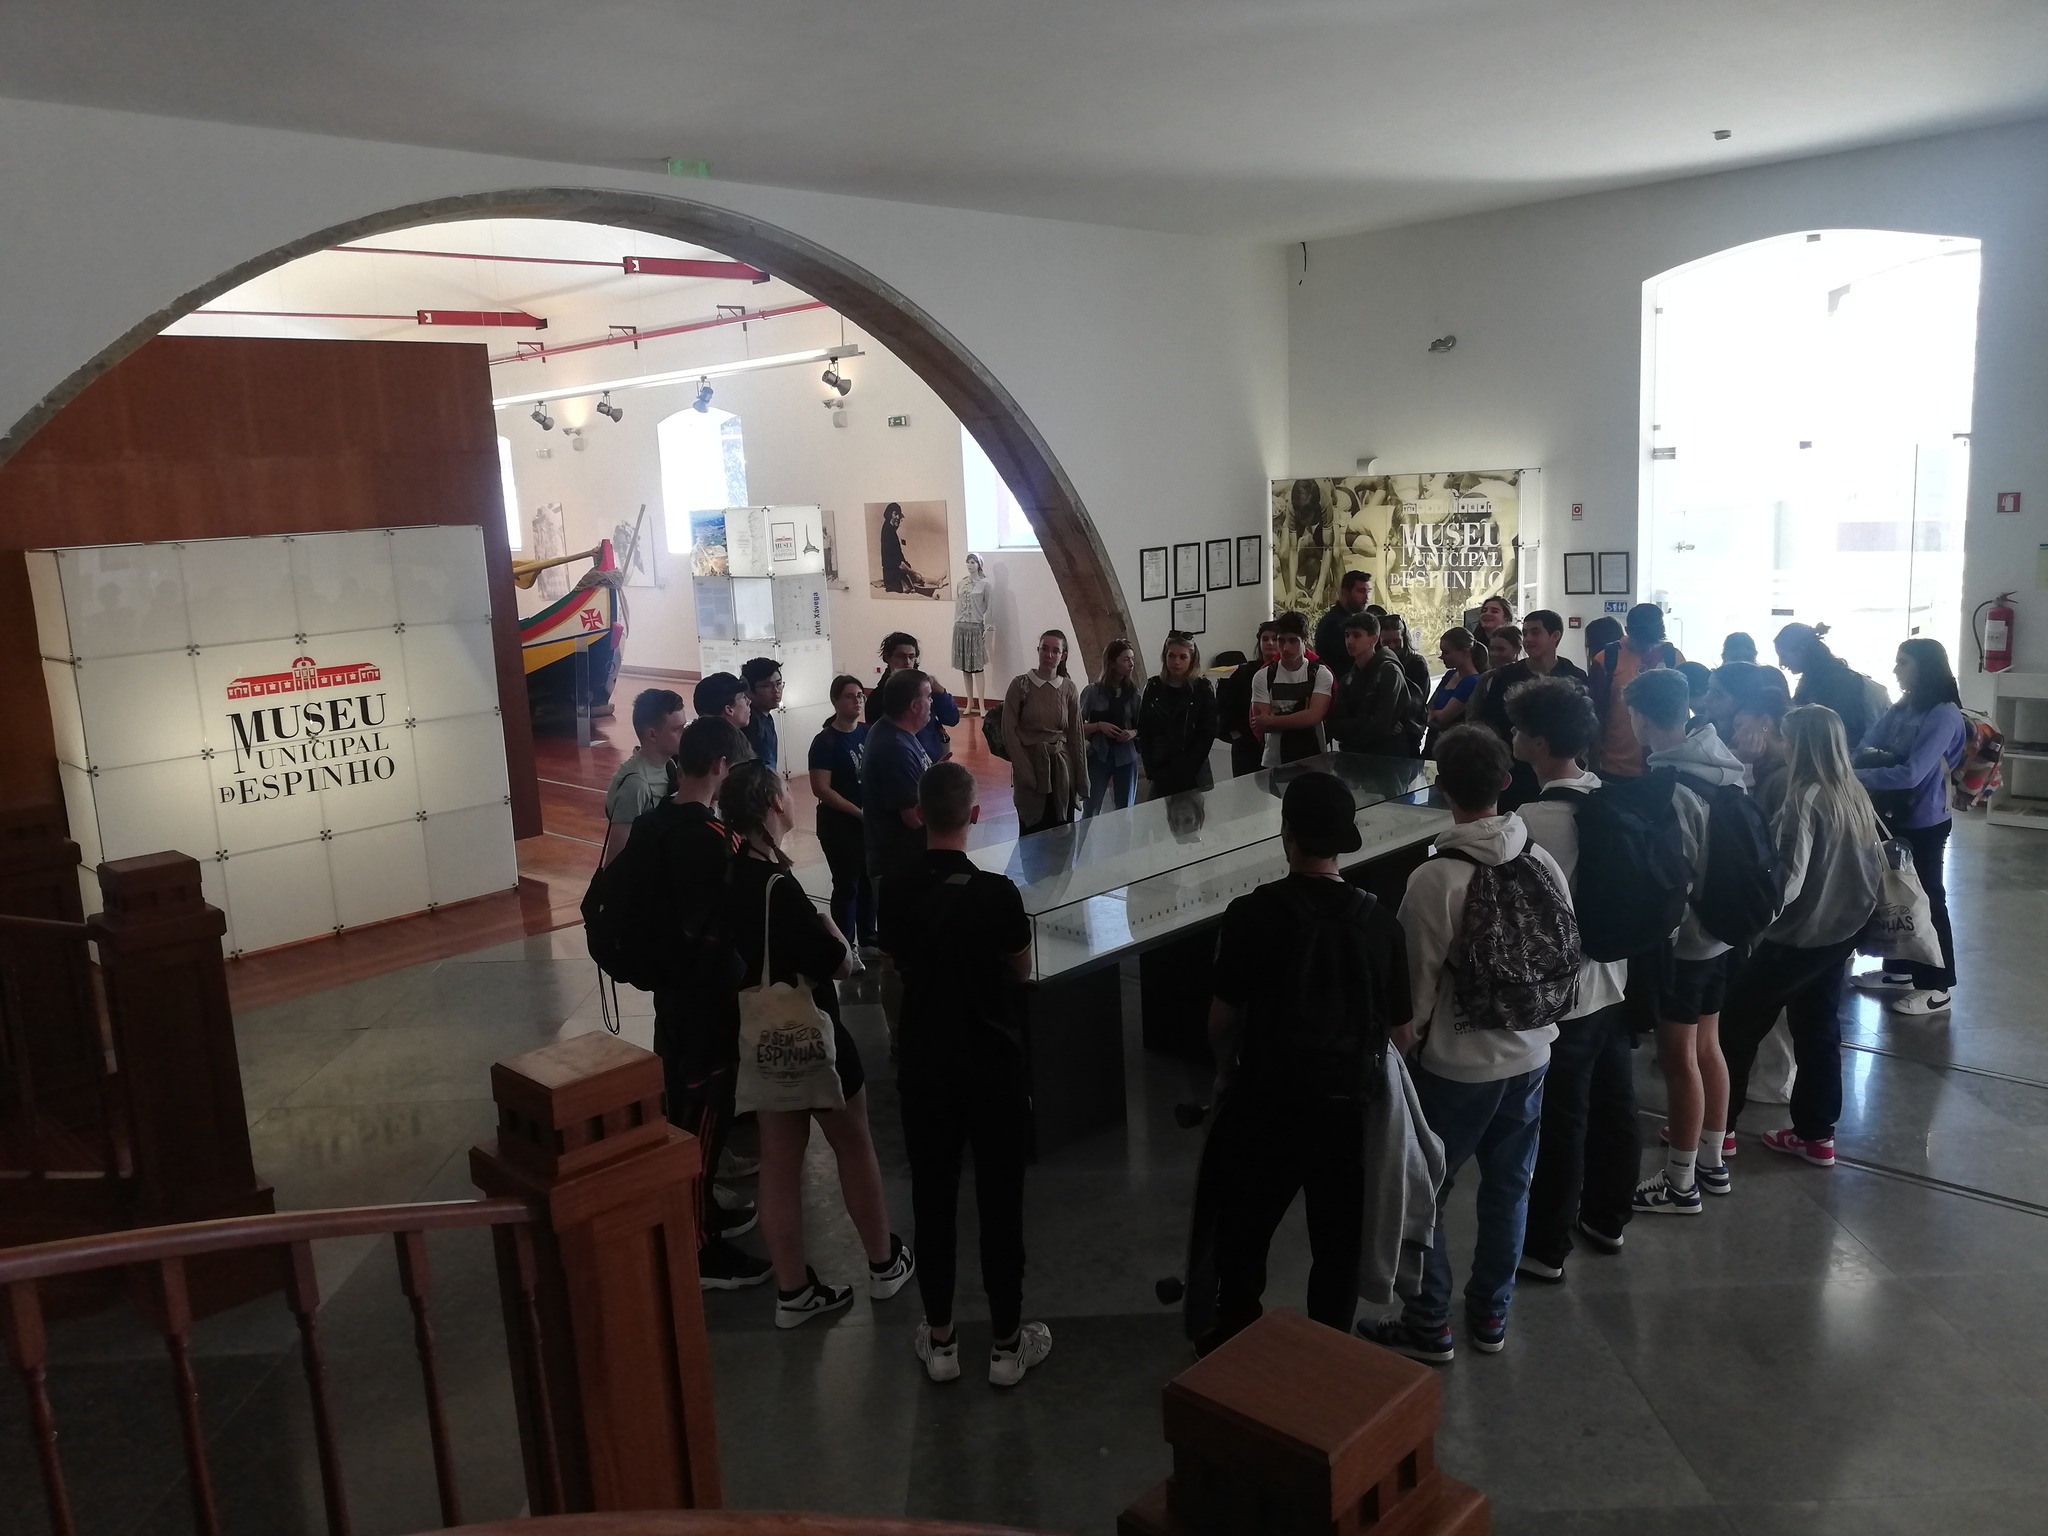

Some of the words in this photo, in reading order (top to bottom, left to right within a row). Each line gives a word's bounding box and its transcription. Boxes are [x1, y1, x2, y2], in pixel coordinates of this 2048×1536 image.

[1400, 522, 1501, 567] MUSEU
[226, 693, 387, 774] MUSEU
[771, 1031, 795, 1047] SEM
